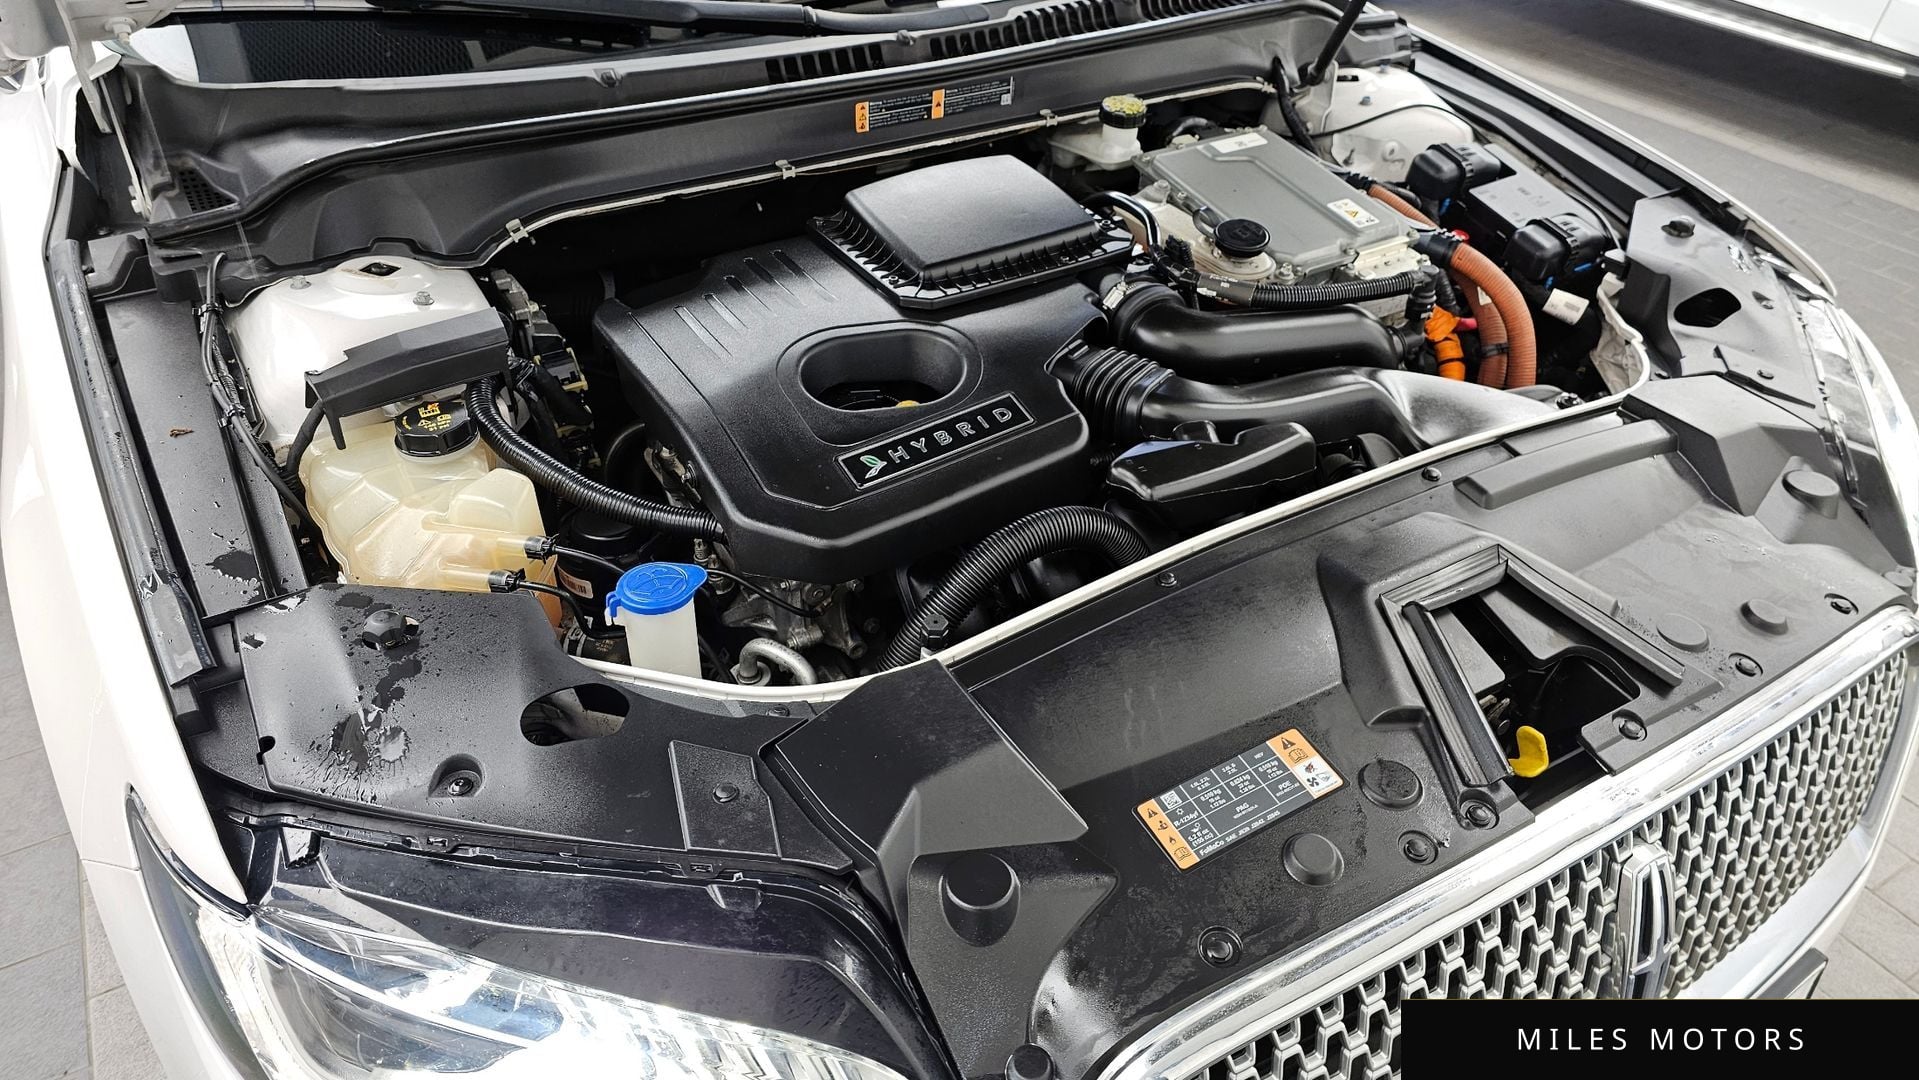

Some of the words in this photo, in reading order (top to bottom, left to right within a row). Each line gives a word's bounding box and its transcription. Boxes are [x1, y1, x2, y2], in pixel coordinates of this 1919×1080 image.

[888, 407, 1012, 463] HYBRID
[1278, 780, 1292, 790] POE
[1236, 802, 1250, 813] PAG
[1200, 840, 1225, 856] FoMoCo
[1226, 832, 1238, 843] SAE
